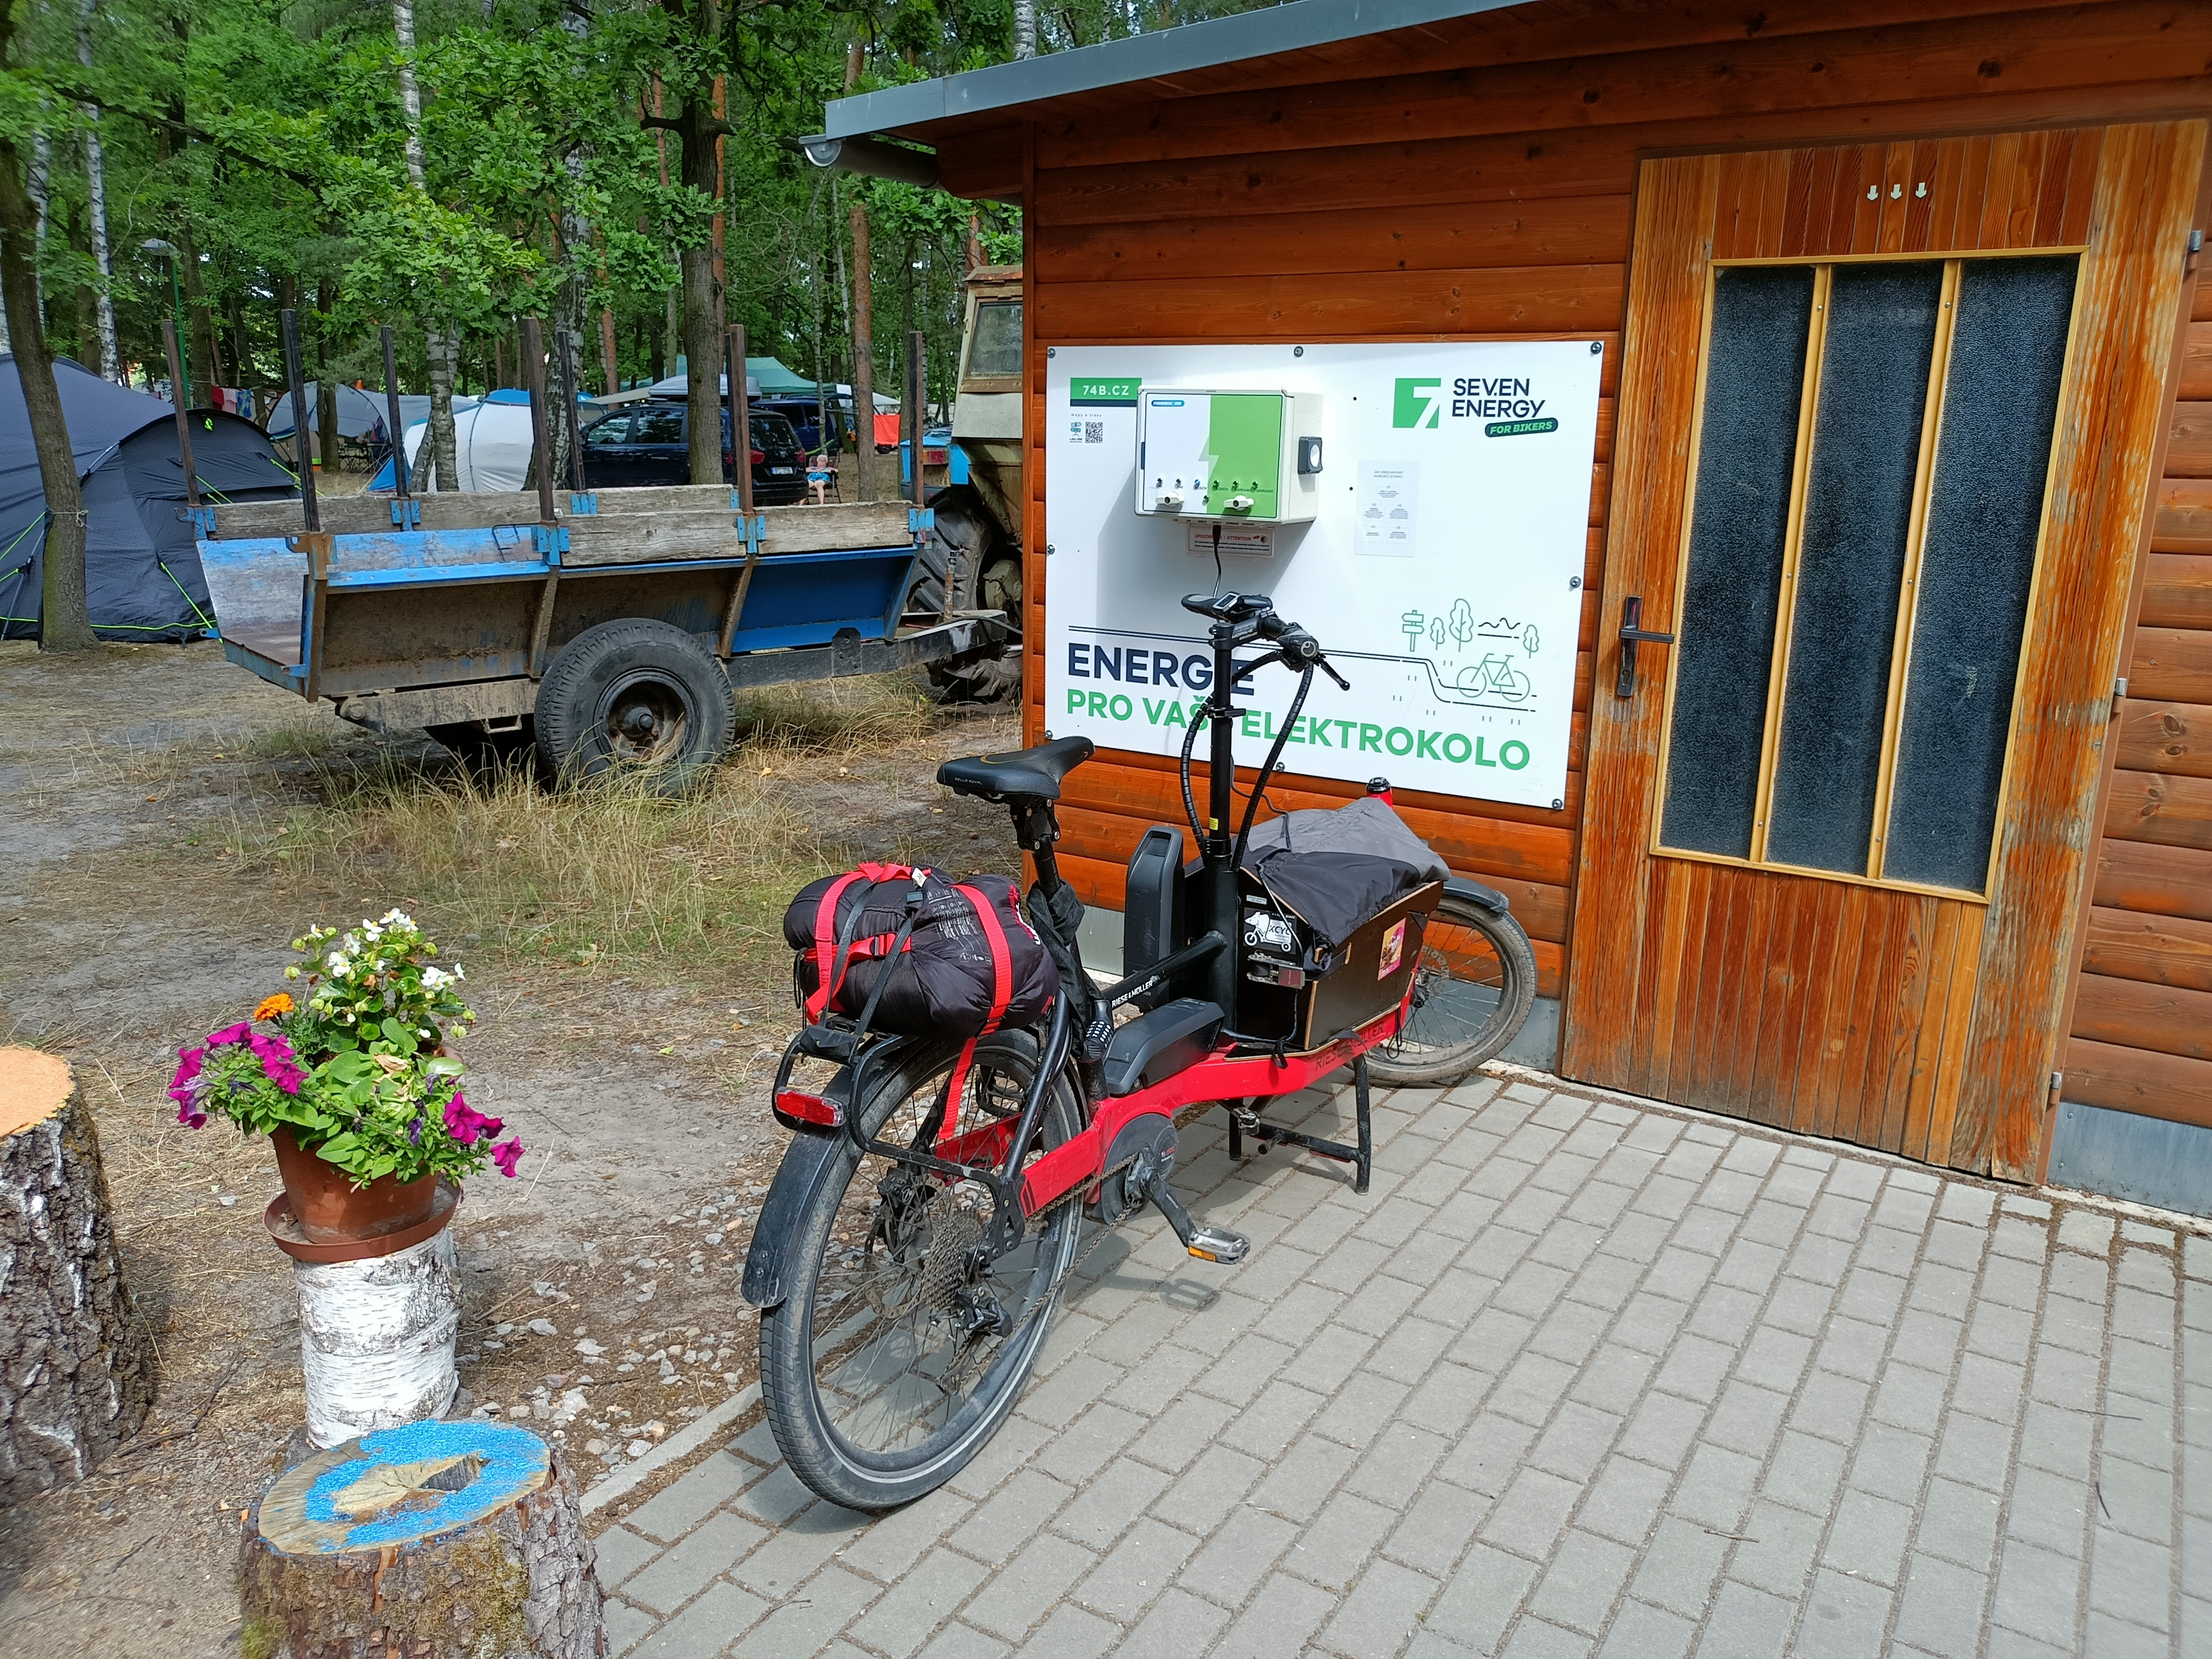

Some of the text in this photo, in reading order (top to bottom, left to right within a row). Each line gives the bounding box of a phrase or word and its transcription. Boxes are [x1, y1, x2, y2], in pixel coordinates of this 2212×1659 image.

[1083, 385, 1129, 395] 74B.CZ
[1452, 400, 1546, 418] ENERGY
[1490, 421, 1552, 434] FOR BIKERS
[1068, 642, 1254, 696] ENERGE
[1067, 688, 1133, 721] PRO
[1241, 709, 1530, 770] ELEKTROKOLO
